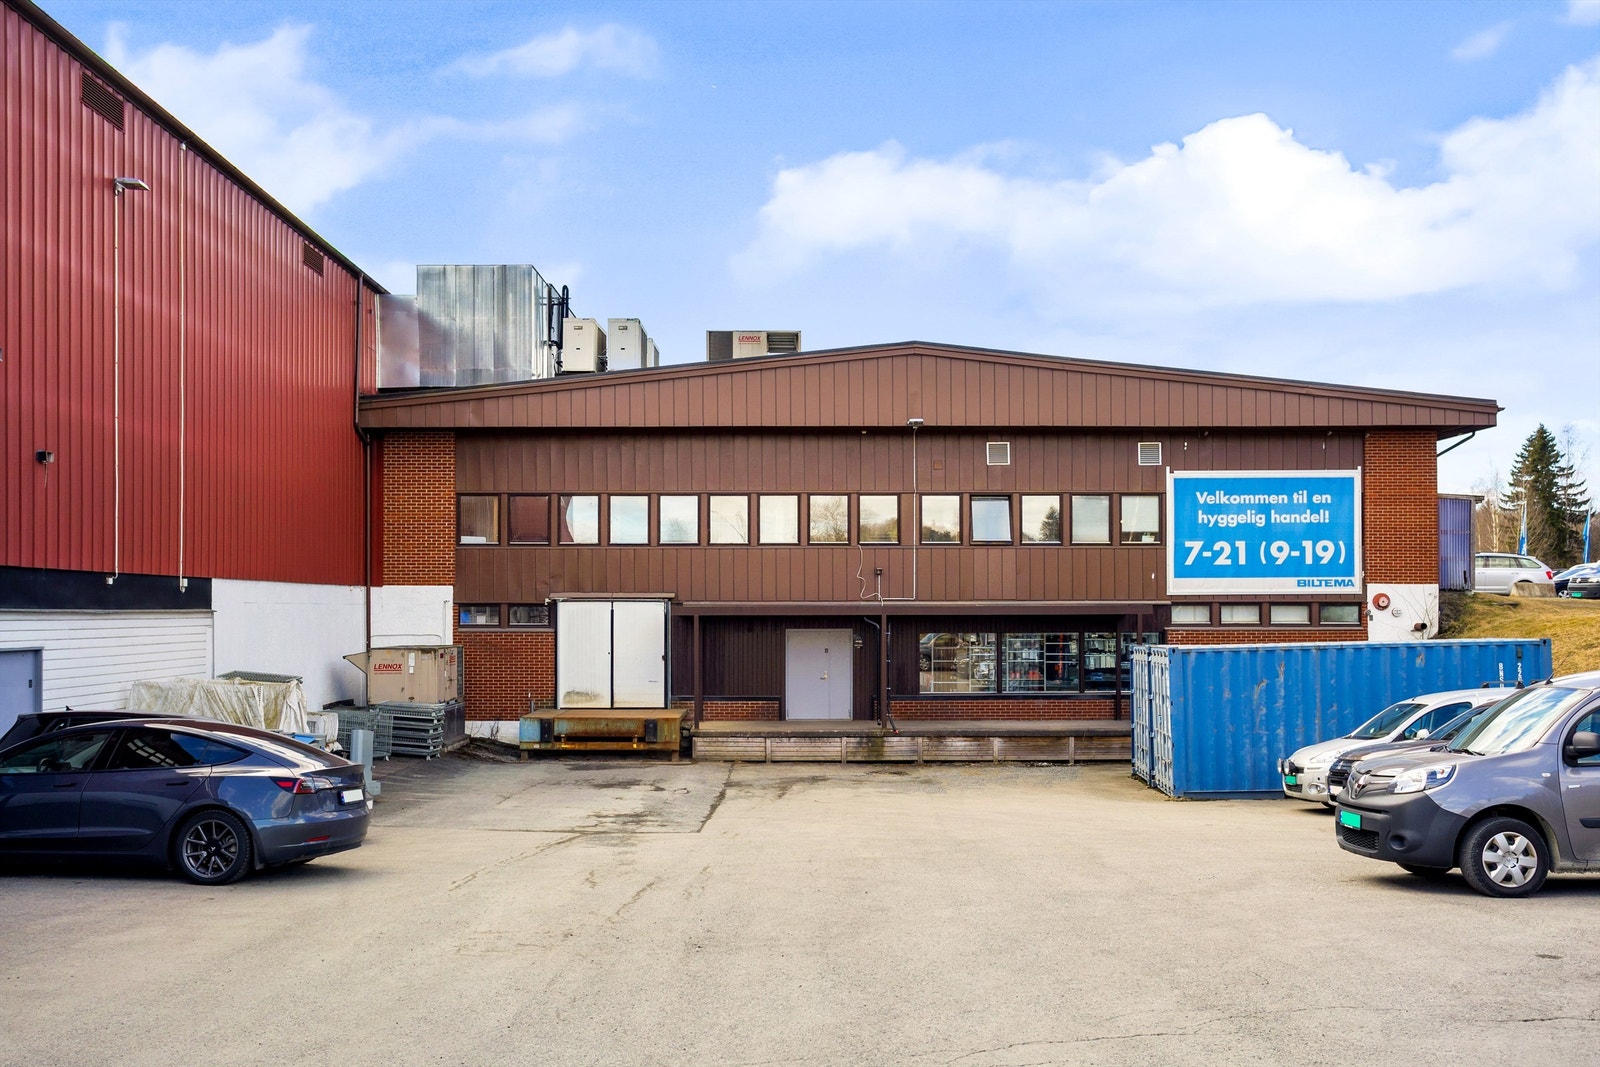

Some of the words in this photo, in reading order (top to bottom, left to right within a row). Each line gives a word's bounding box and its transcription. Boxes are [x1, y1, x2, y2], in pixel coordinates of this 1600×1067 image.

[1196, 490, 1288, 504] Velkommen
[1293, 490, 1307, 504] til
[1312, 493, 1332, 504] en
[1198, 510, 1265, 527] hyggelig
[1271, 509, 1329, 524] handel!
[1184, 540, 1246, 566] 7-21
[1259, 540, 1346, 565] (9-19)
[1297, 579, 1355, 588] BILTEMA
